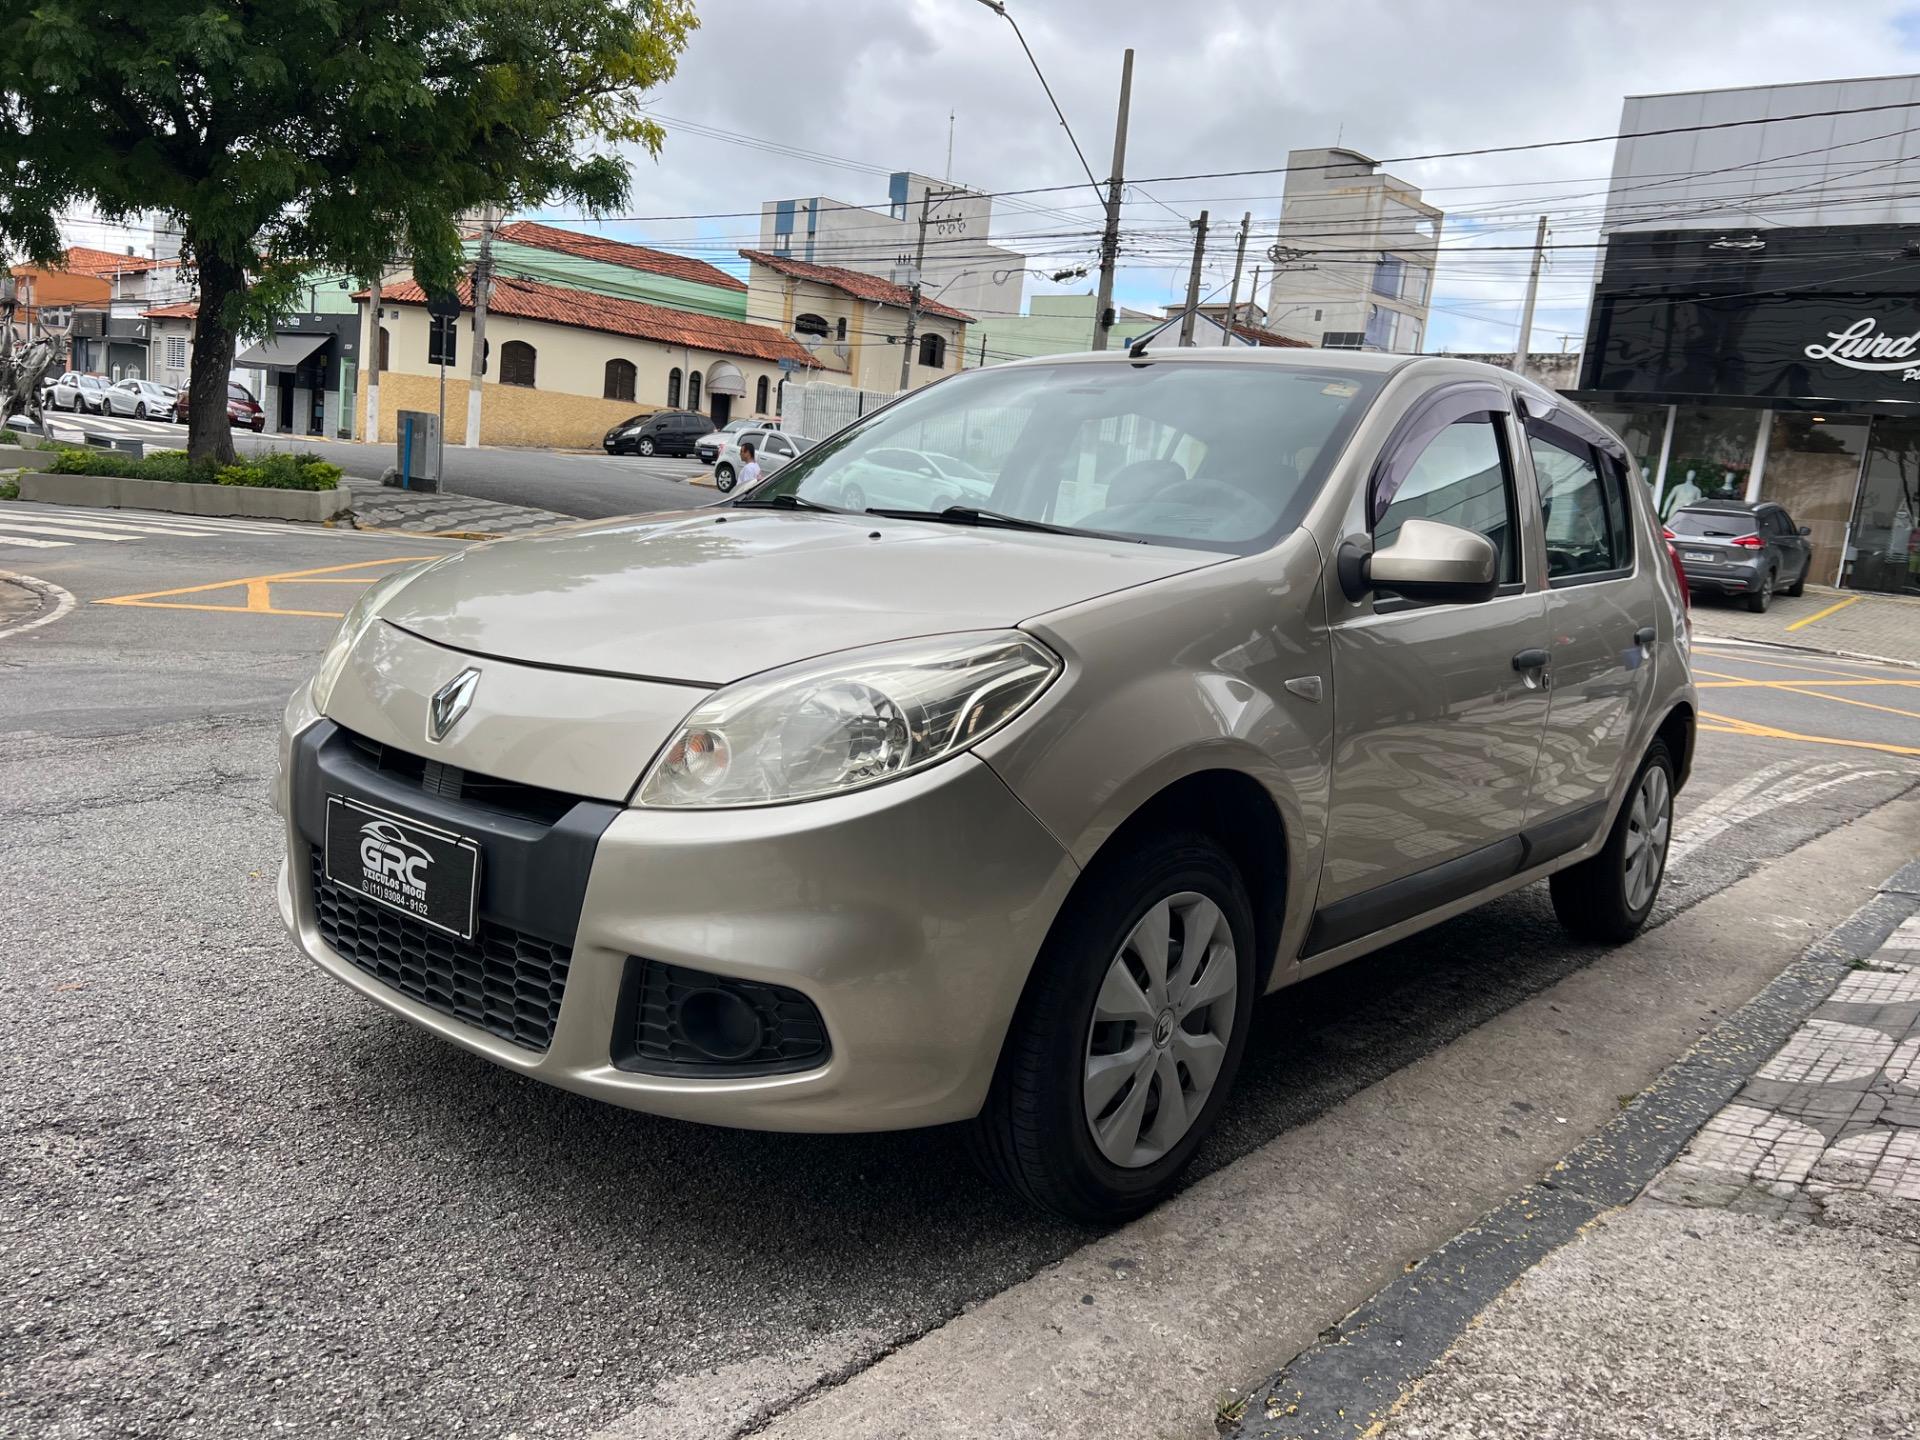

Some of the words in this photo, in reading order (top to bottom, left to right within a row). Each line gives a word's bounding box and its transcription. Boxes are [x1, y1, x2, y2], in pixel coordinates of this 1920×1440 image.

[360, 837, 428, 890] GRC
[363, 866, 400, 890] VEICULOS
[402, 883, 426, 901] MOGI
